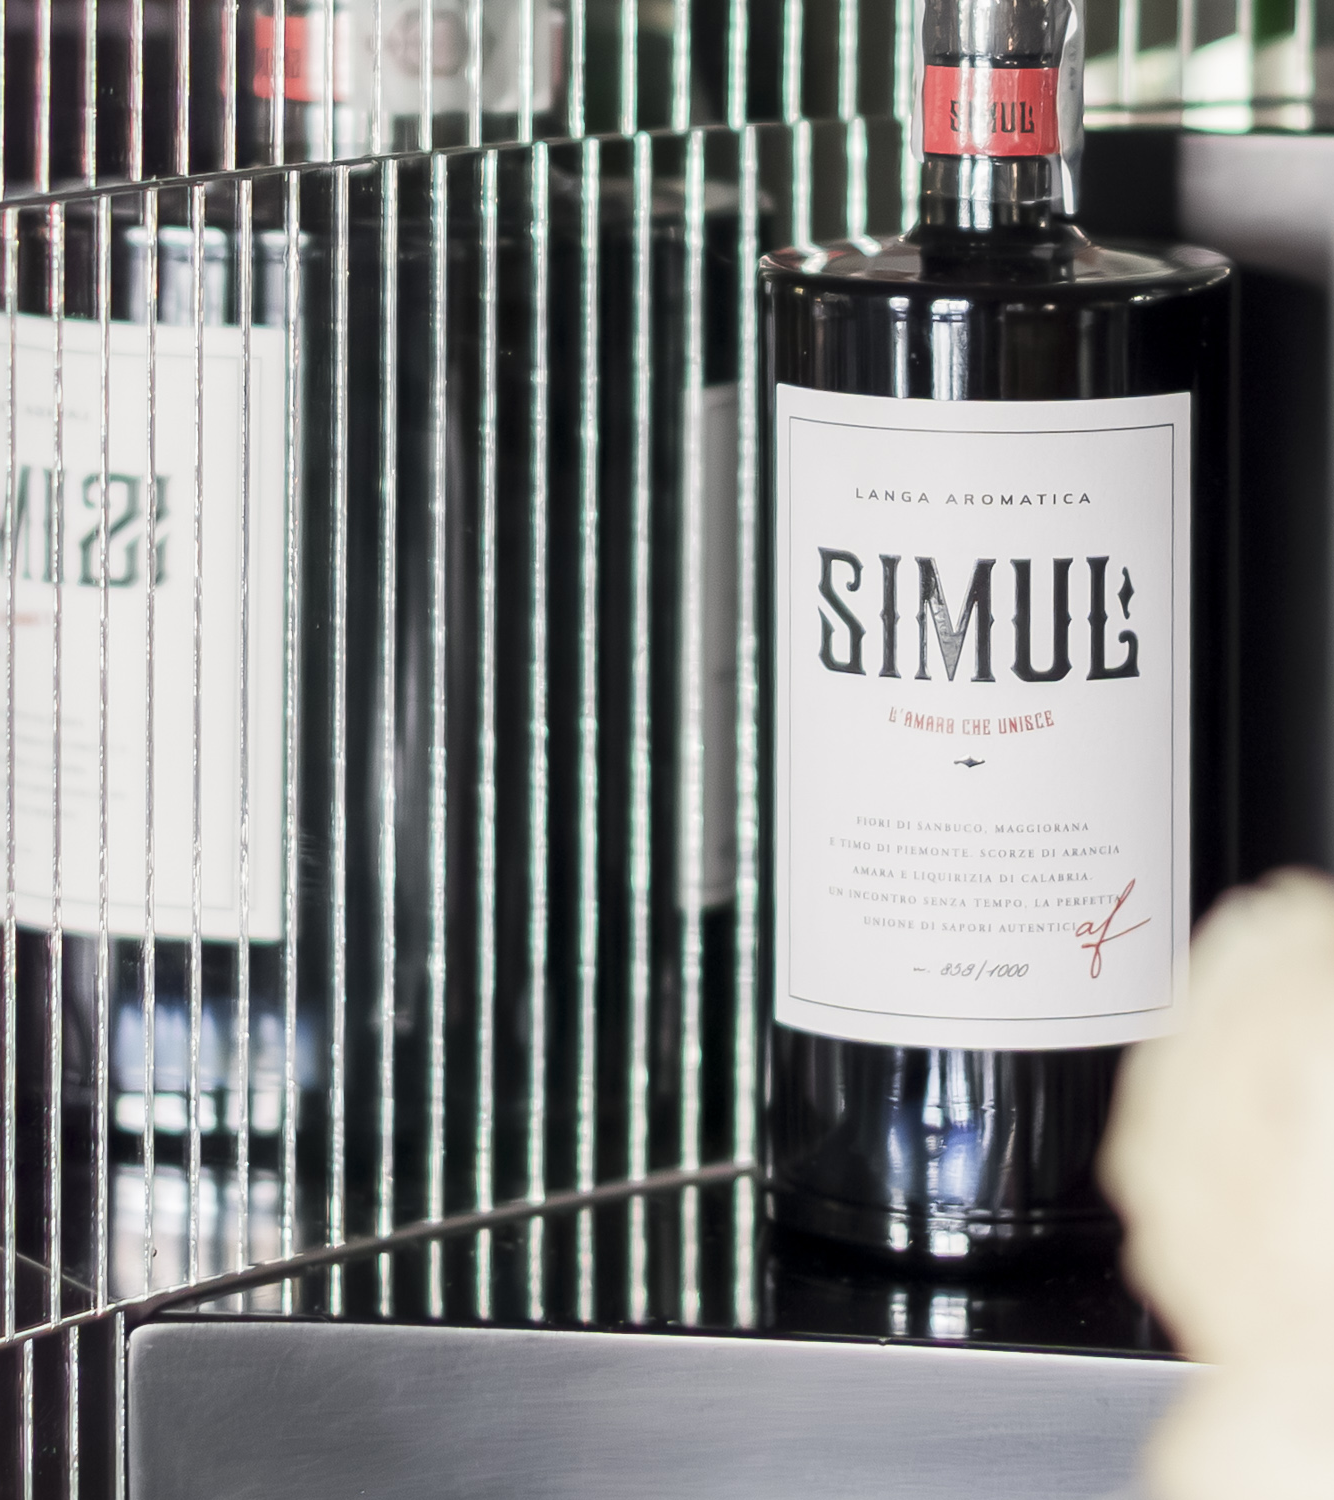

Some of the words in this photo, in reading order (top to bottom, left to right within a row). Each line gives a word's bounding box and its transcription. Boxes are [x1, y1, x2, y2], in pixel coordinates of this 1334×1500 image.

[855, 487, 930, 503] LANGA
[945, 493, 1092, 505] AROMATICA
[817, 546, 1140, 682] SIMUL
[962, 719, 991, 735] CHE
[998, 709, 1055, 734] UNISCE
[856, 816, 891, 828] FIORI
[896, 820, 911, 830] DI
[995, 822, 1089, 834] MAGGIORANA
[829, 836, 836, 846] E
[840, 838, 872, 850] TIMO
[876, 843, 890, 853] DI
[979, 848, 1035, 858] SCORZE
[1041, 848, 1056, 857] DI
[1062, 844, 1120, 857] ARANCIA
[853, 866, 894, 878] AMARA
[900, 870, 907, 879] E
[913, 871, 992, 883] LIQUIRIZIA
[999, 873, 1014, 883] DI
[828, 886, 843, 896] UN
[849, 889, 916, 904] INCONTRO
[923, 897, 966, 907] SENZA
[1034, 899, 1050, 907] LA
[864, 916, 915, 929] UNIONE
[920, 921, 935, 930] DI
[942, 922, 992, 932] SAPORI
